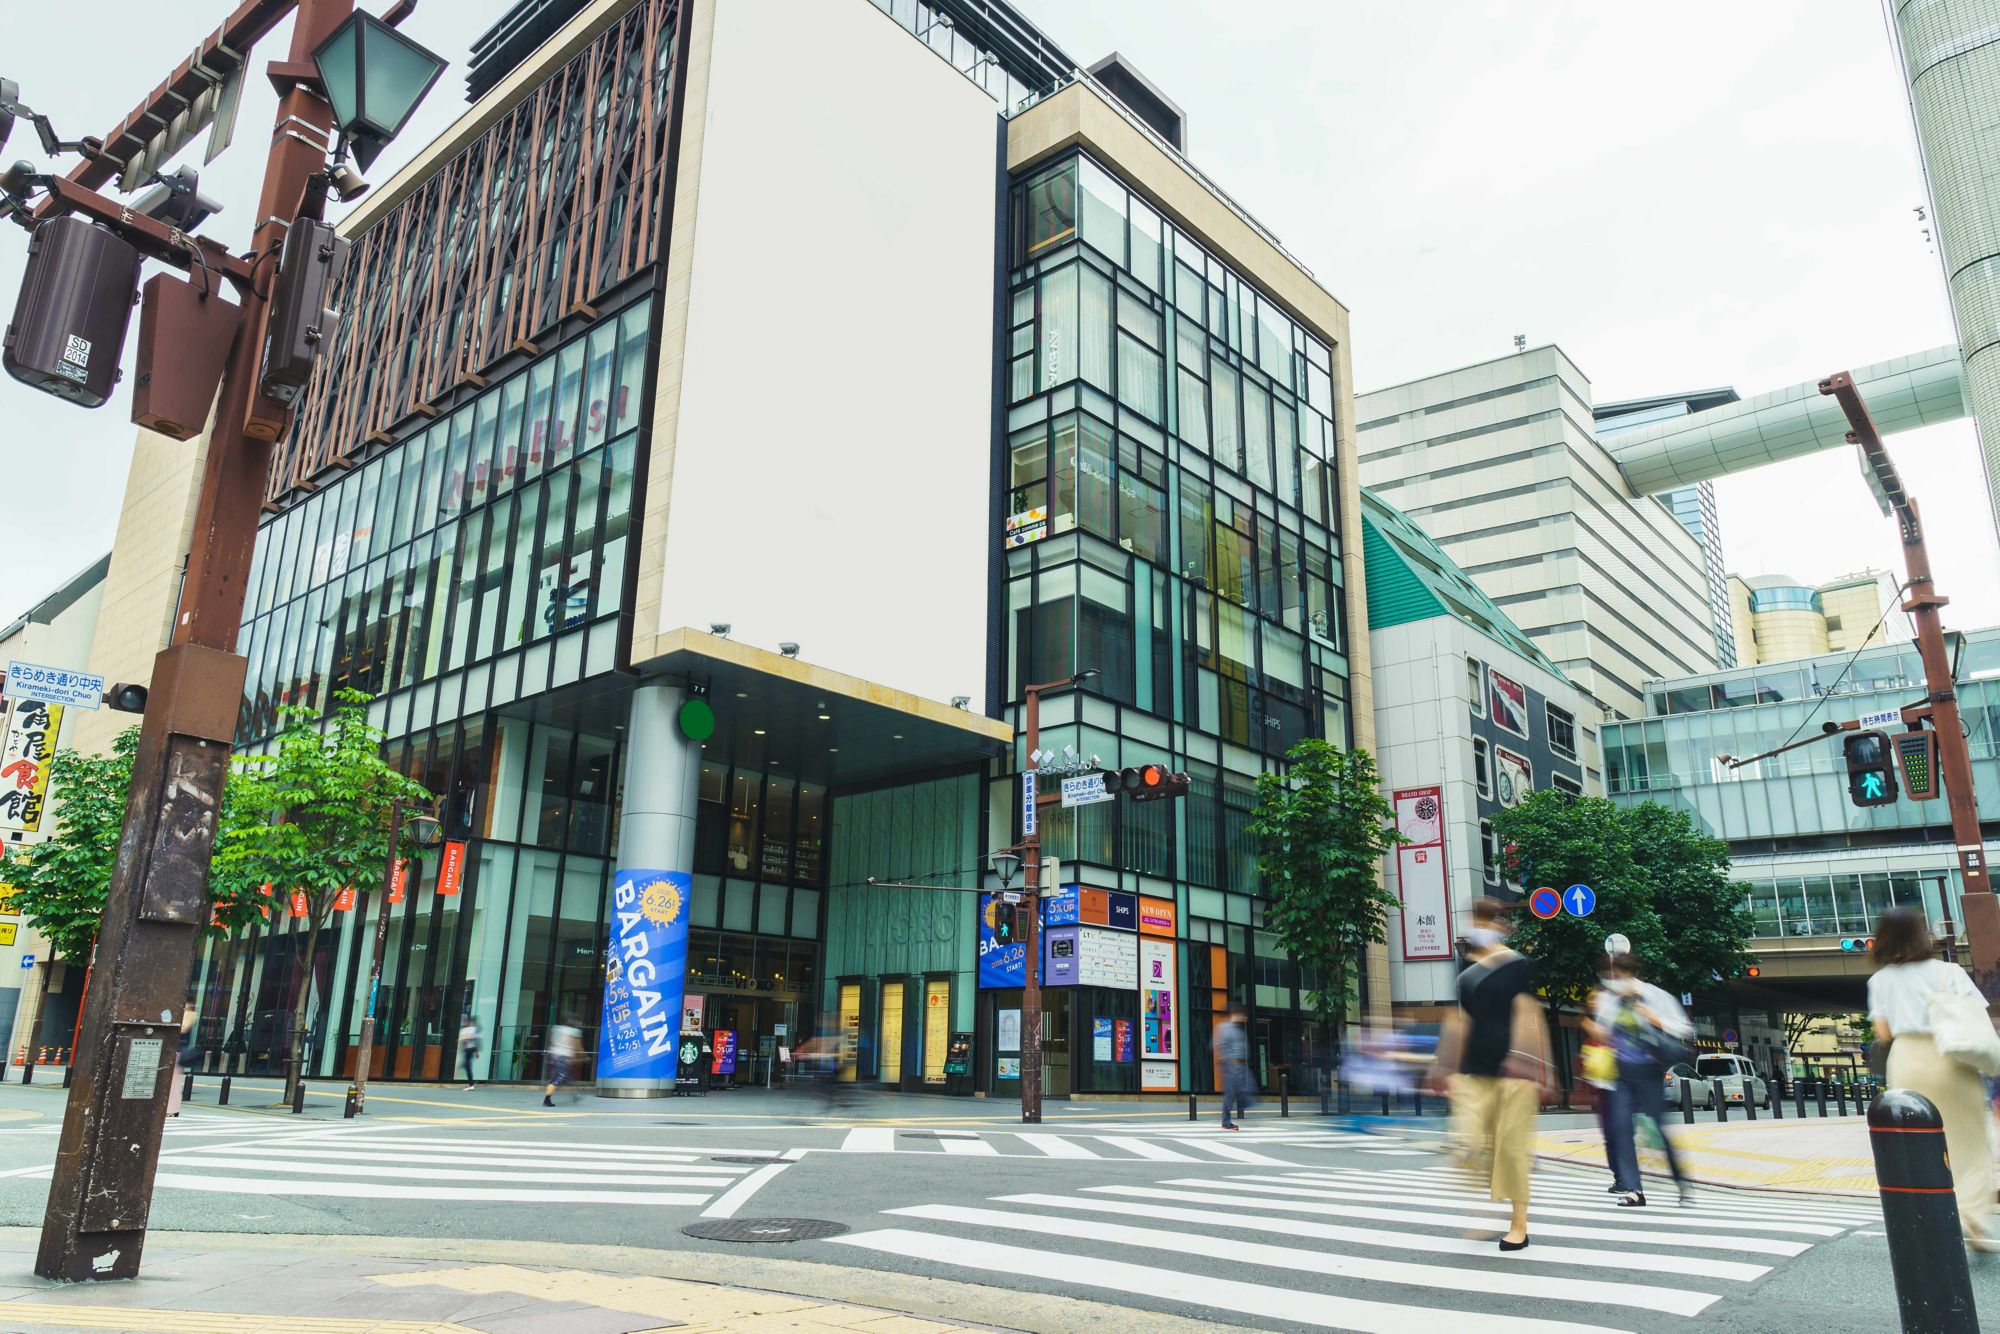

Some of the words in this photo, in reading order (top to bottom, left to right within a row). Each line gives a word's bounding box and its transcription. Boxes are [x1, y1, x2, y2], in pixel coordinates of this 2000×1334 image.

[72, 337, 87, 351] SD
[66, 349, 86, 364] 2014
[11, 666, 101, 692] きらめき通り中央
[16, 681, 69, 695] Kirameki-dori
[72, 690, 92, 699] Chuo
[31, 692, 76, 703] INTERSECTION
[1861, 711, 1899, 726] 待ち時間表示
[1064, 777, 1105, 792] きらめき通り中
[1025, 775, 1033, 832] 歩車分離信号
[445, 849, 457, 888] BARGAIN
[646, 895, 672, 909] 6.26
[650, 907, 668, 915] START
[1115, 905, 1129, 915] SHIPS
[1141, 905, 1154, 915] NEW
[1155, 908, 1171, 918] OPEN
[1003, 945, 1025, 964] 6.26
[615, 880, 671, 1057] BARGAIN
[609, 985, 629, 1005] 5%
[612, 1001, 629, 1013] POINT
[613, 1009, 631, 1024] UP
[619, 1022, 631, 1031] 2020
